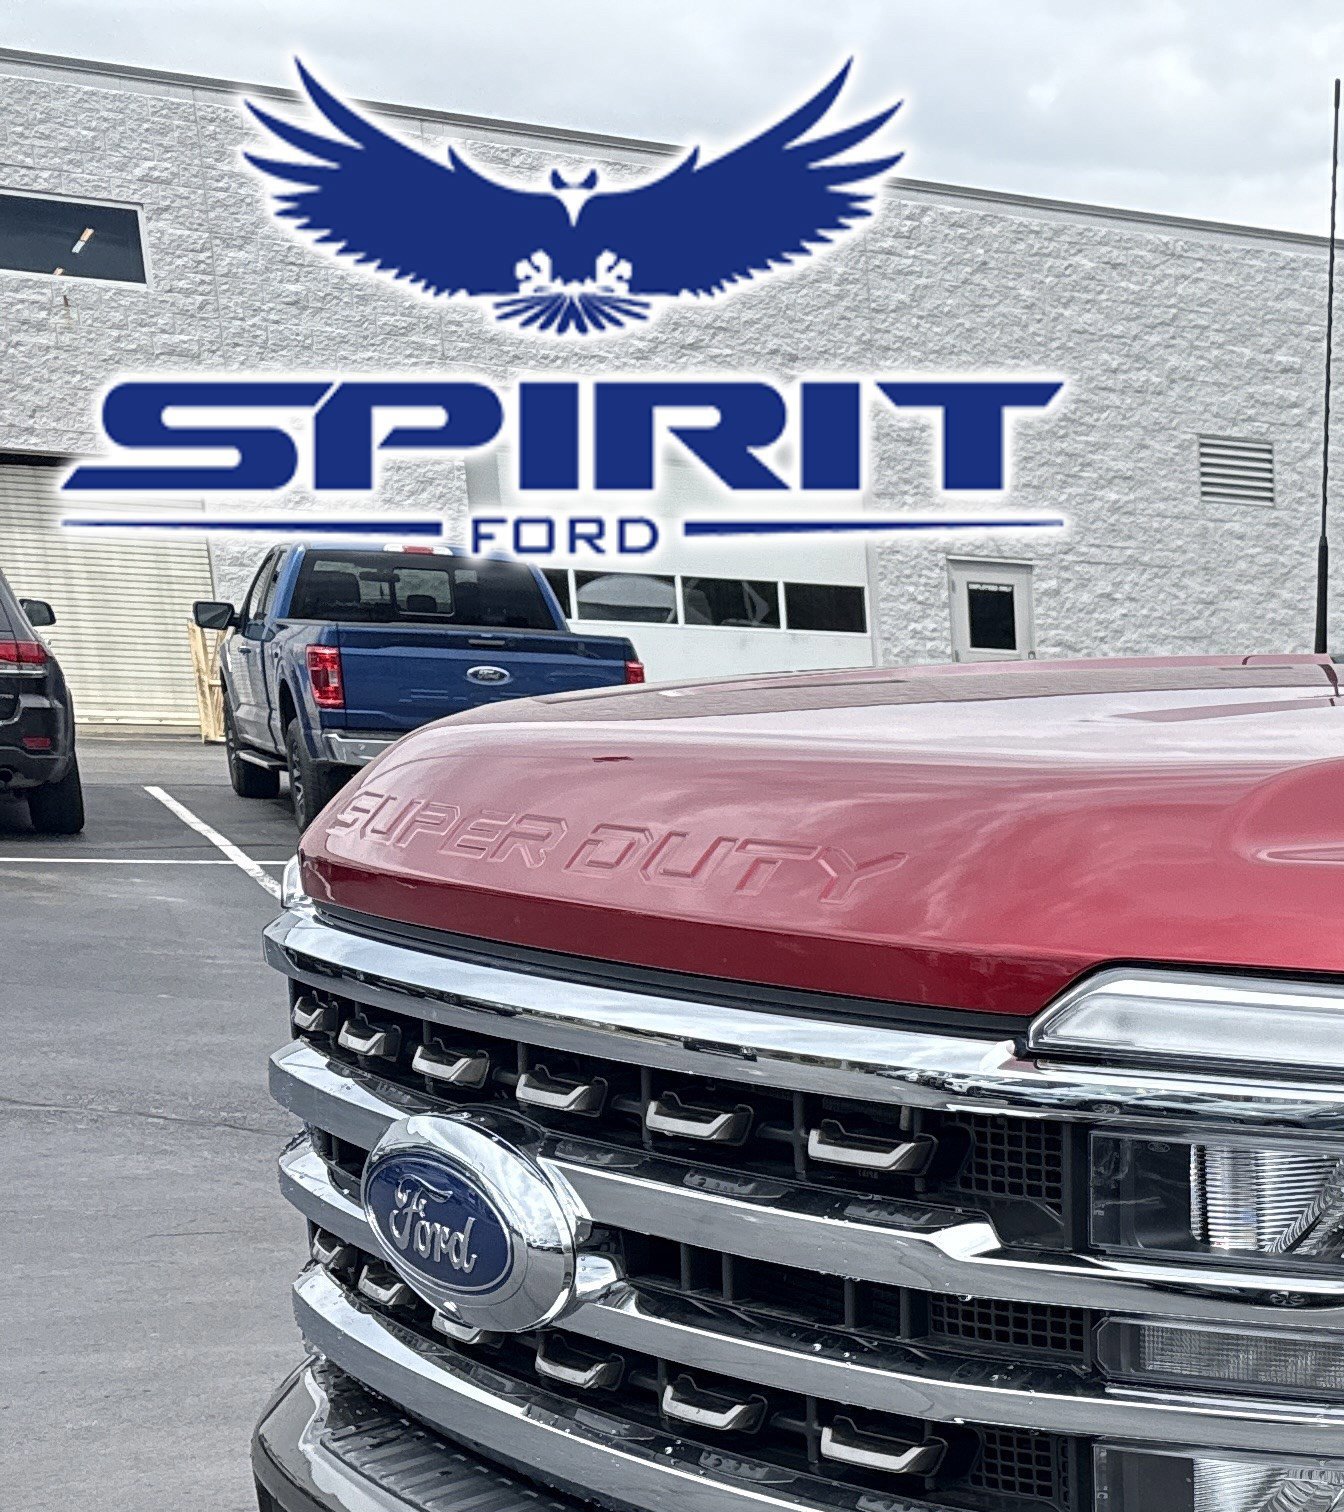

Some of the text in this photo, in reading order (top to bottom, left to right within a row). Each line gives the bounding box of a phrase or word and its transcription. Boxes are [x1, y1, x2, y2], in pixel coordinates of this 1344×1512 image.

[326, 790, 909, 904] SUPER DUTY
[389, 1173, 477, 1273] Ford
